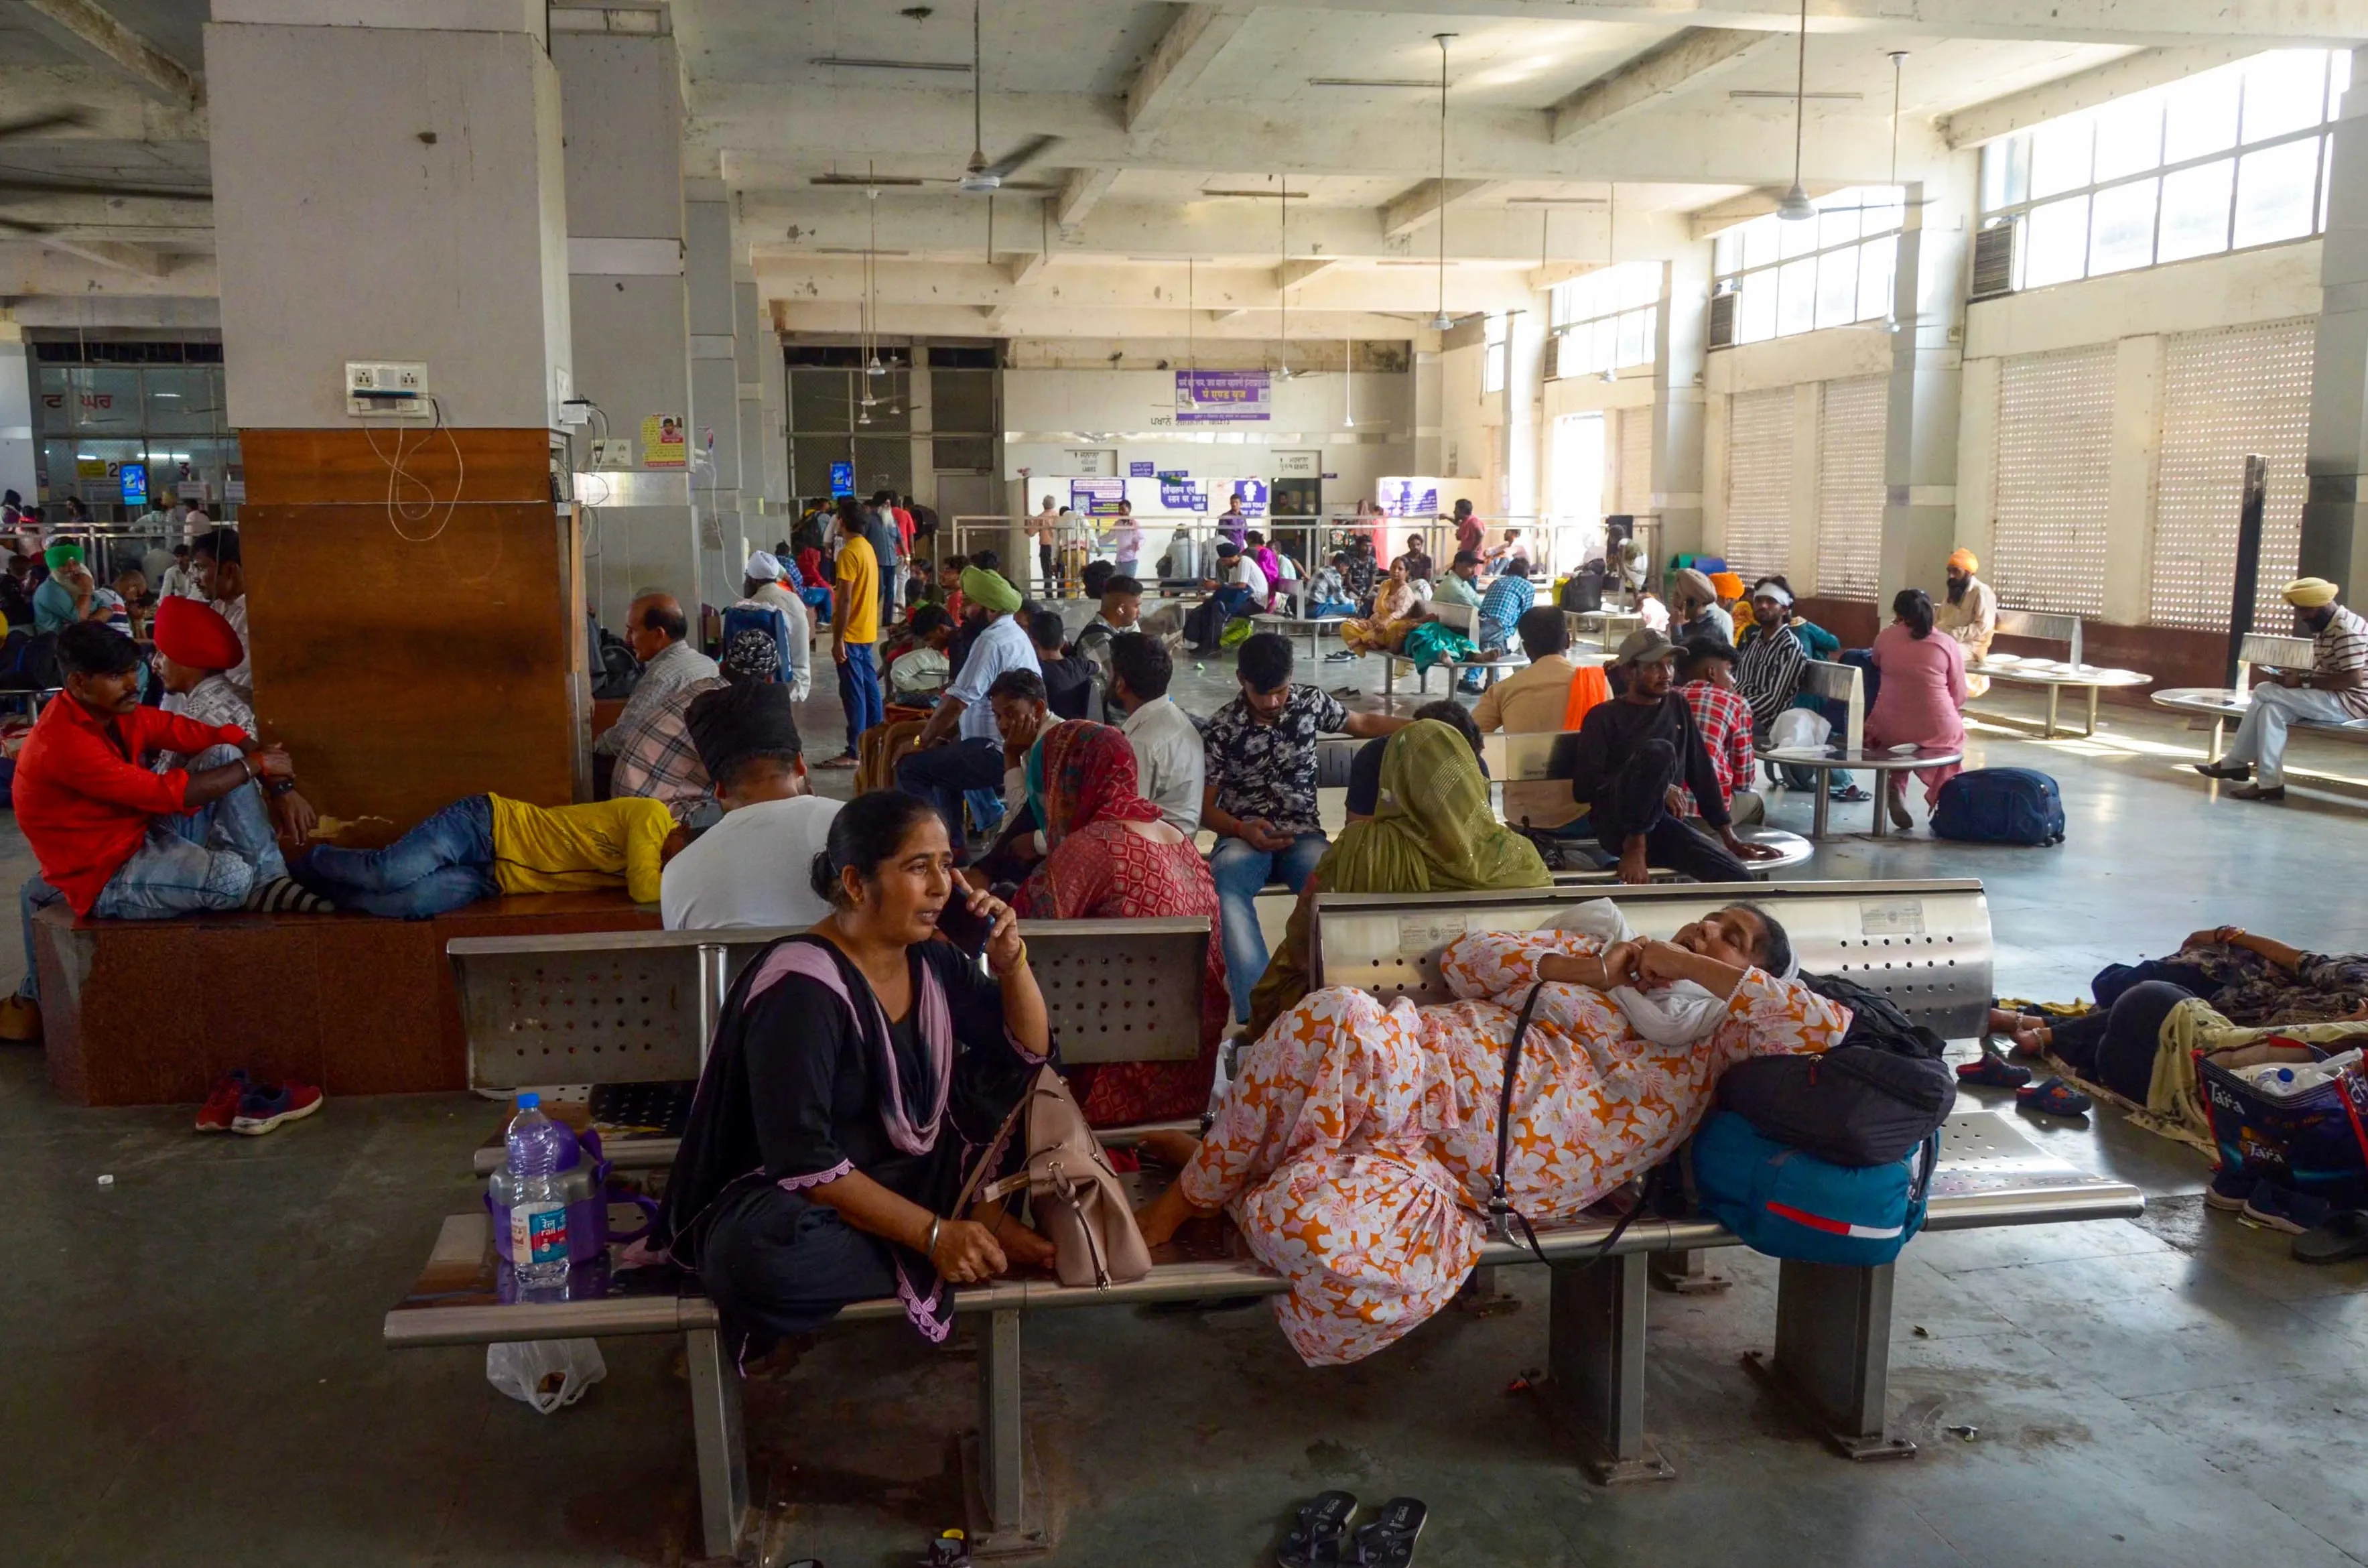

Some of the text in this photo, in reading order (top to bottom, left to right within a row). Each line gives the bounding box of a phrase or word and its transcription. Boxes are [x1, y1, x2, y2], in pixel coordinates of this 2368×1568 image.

[108, 462, 118, 477] 2
[179, 462, 190, 476] 3
[541, 1218, 555, 1230] रेल
[541, 1228, 555, 1236] rail
